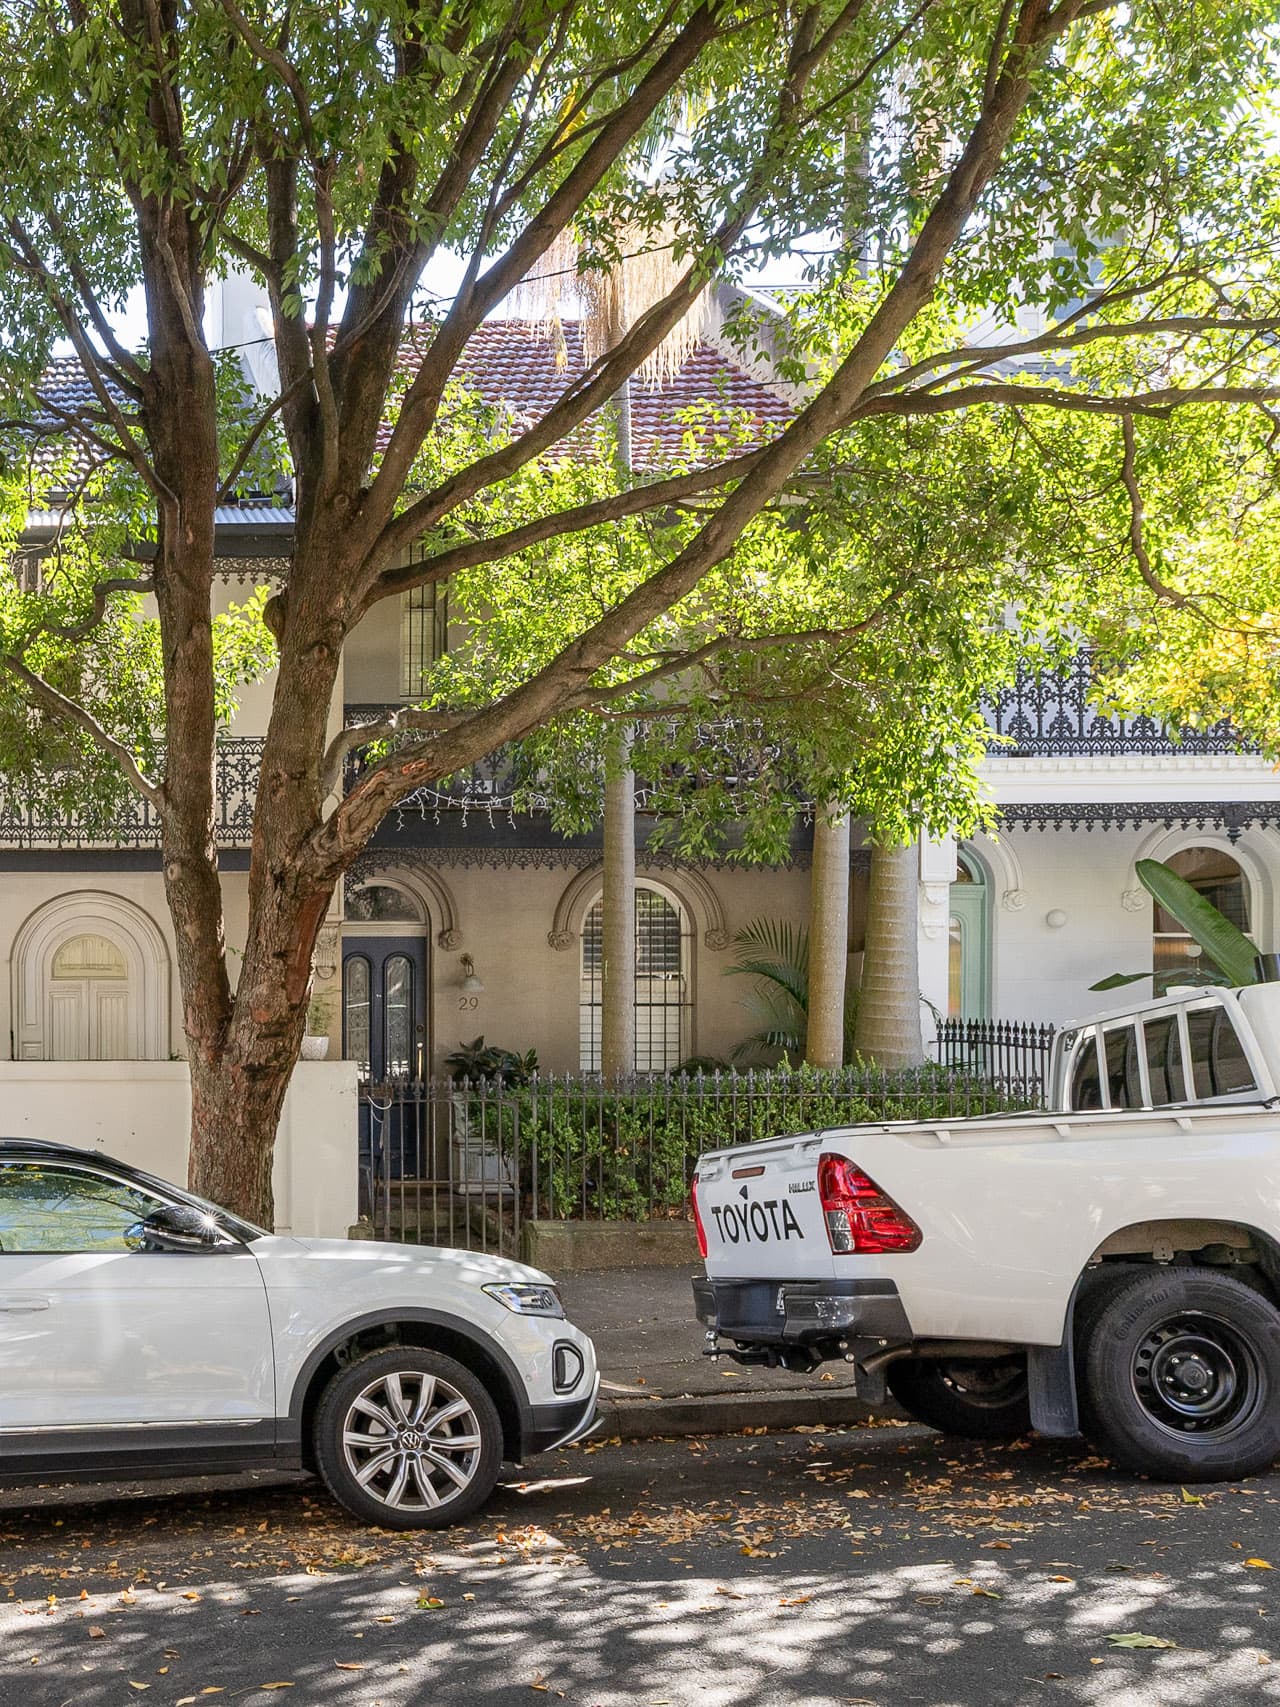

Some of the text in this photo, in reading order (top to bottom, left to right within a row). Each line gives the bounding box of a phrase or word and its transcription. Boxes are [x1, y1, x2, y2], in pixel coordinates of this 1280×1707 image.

[459, 996, 479, 1011] 29
[788, 1181, 816, 1194] HILUX
[711, 1199, 805, 1244] TOYOTA
